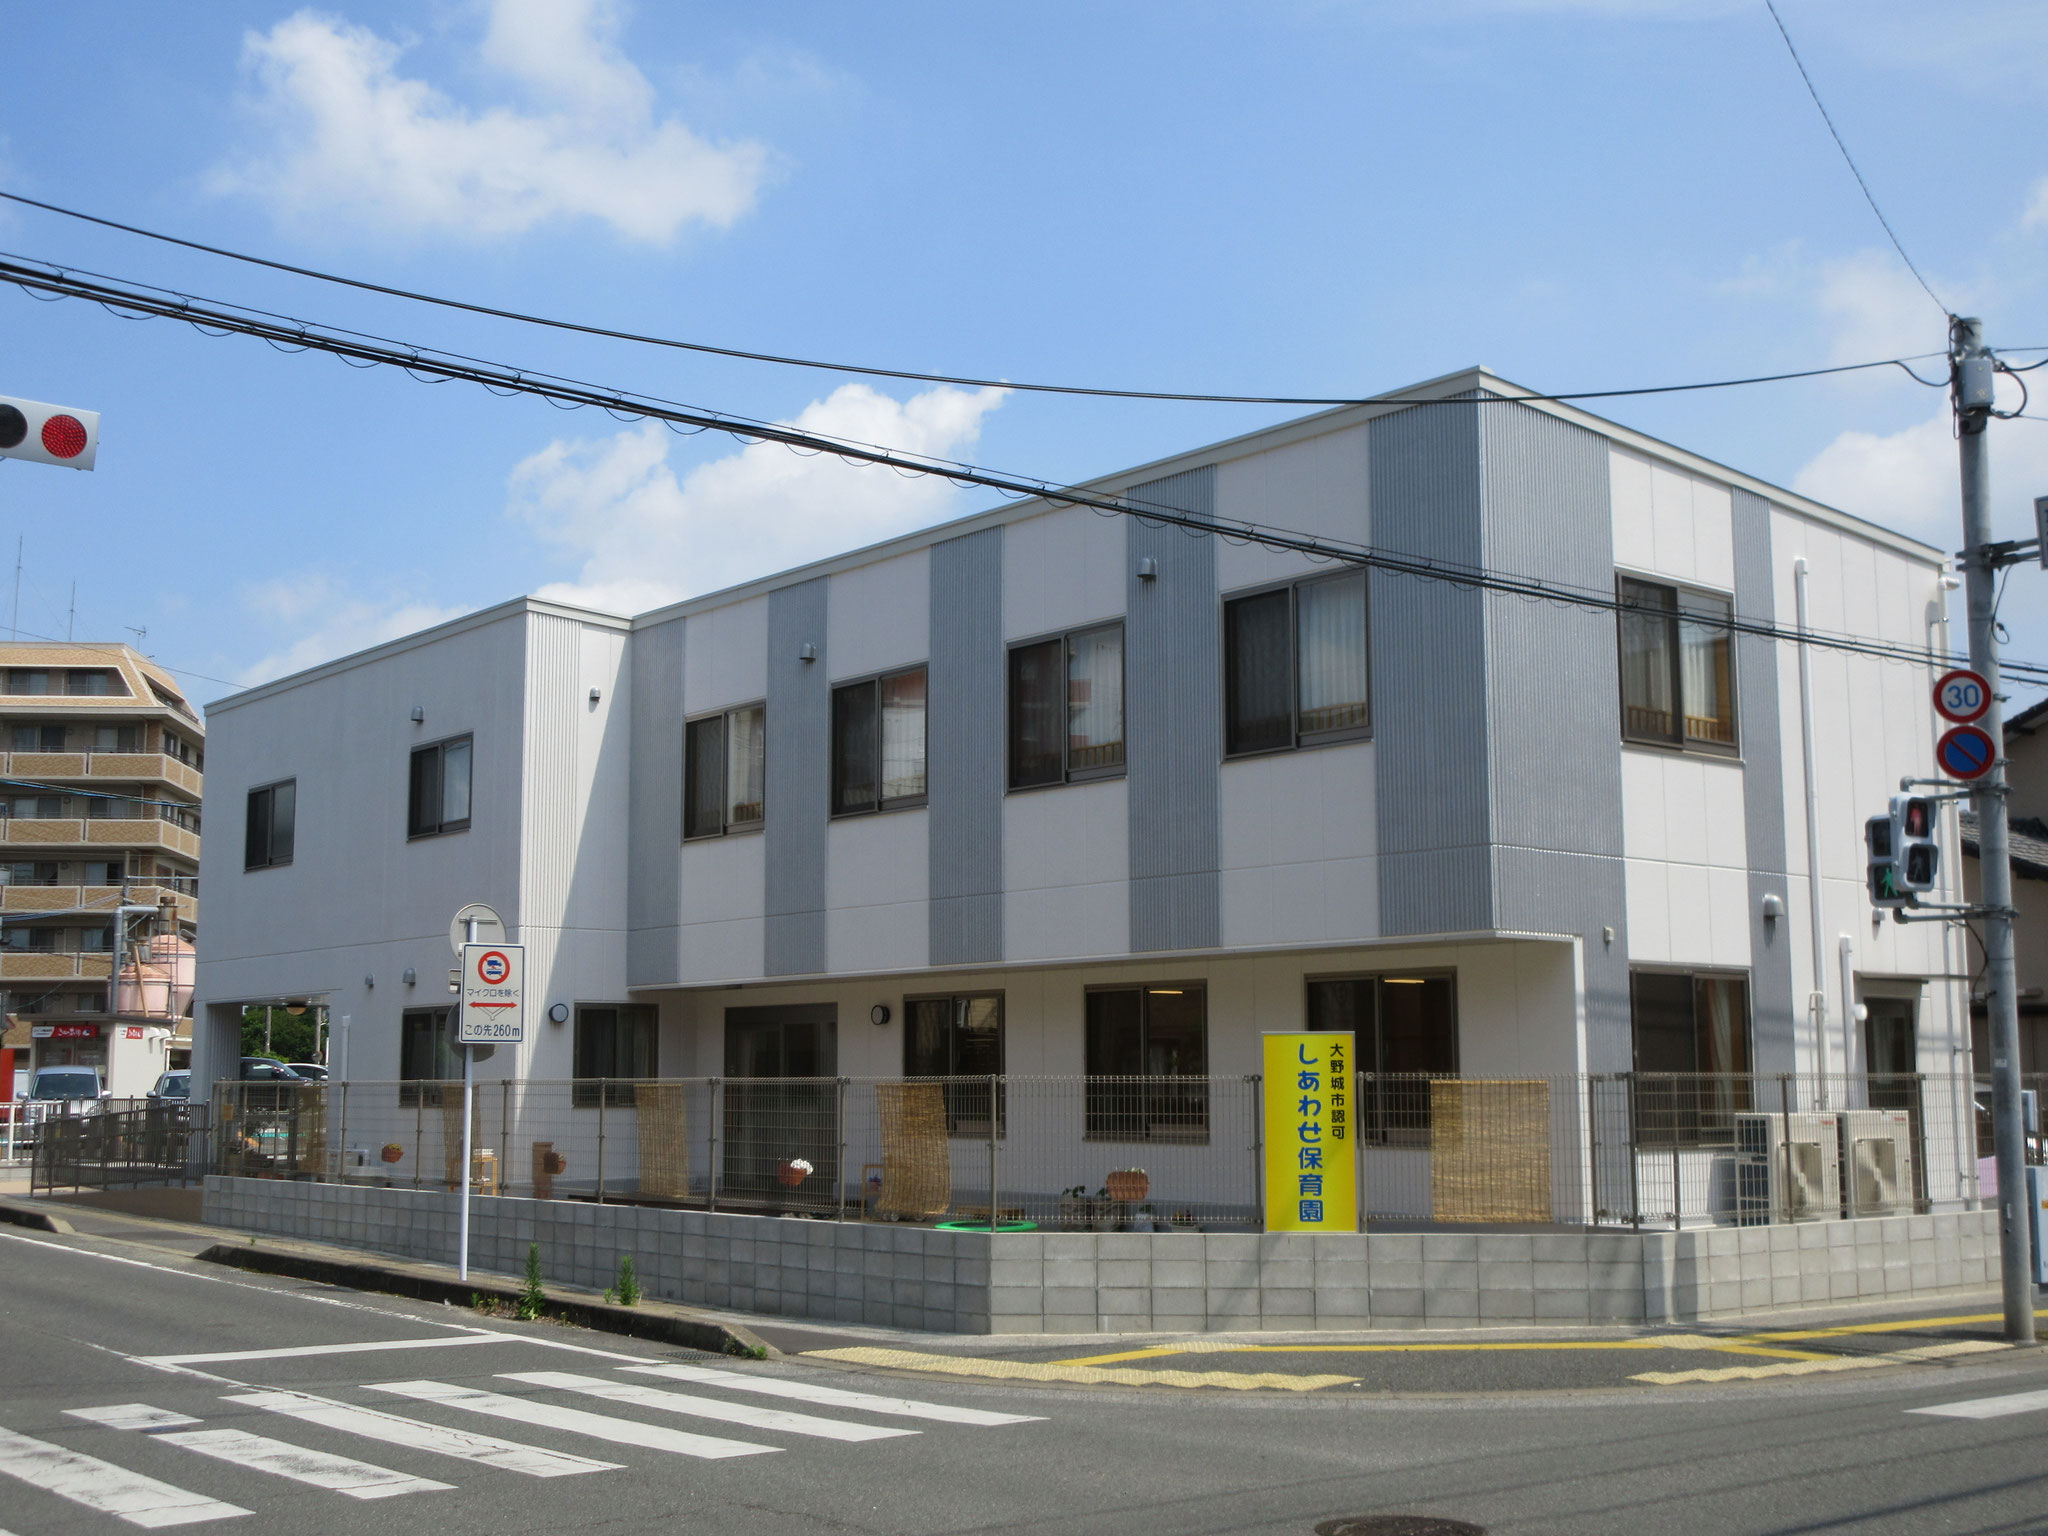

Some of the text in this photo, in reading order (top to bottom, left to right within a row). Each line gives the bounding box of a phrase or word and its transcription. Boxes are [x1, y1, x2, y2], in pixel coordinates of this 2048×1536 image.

[1947, 684, 1979, 708] 30
[466, 988, 520, 998] マイクロを除く
[464, 1024, 520, 1037] この先260m
[1330, 1043, 1345, 1139] 大野城市認可
[1298, 1043, 1323, 1222] しあわせ保育園
